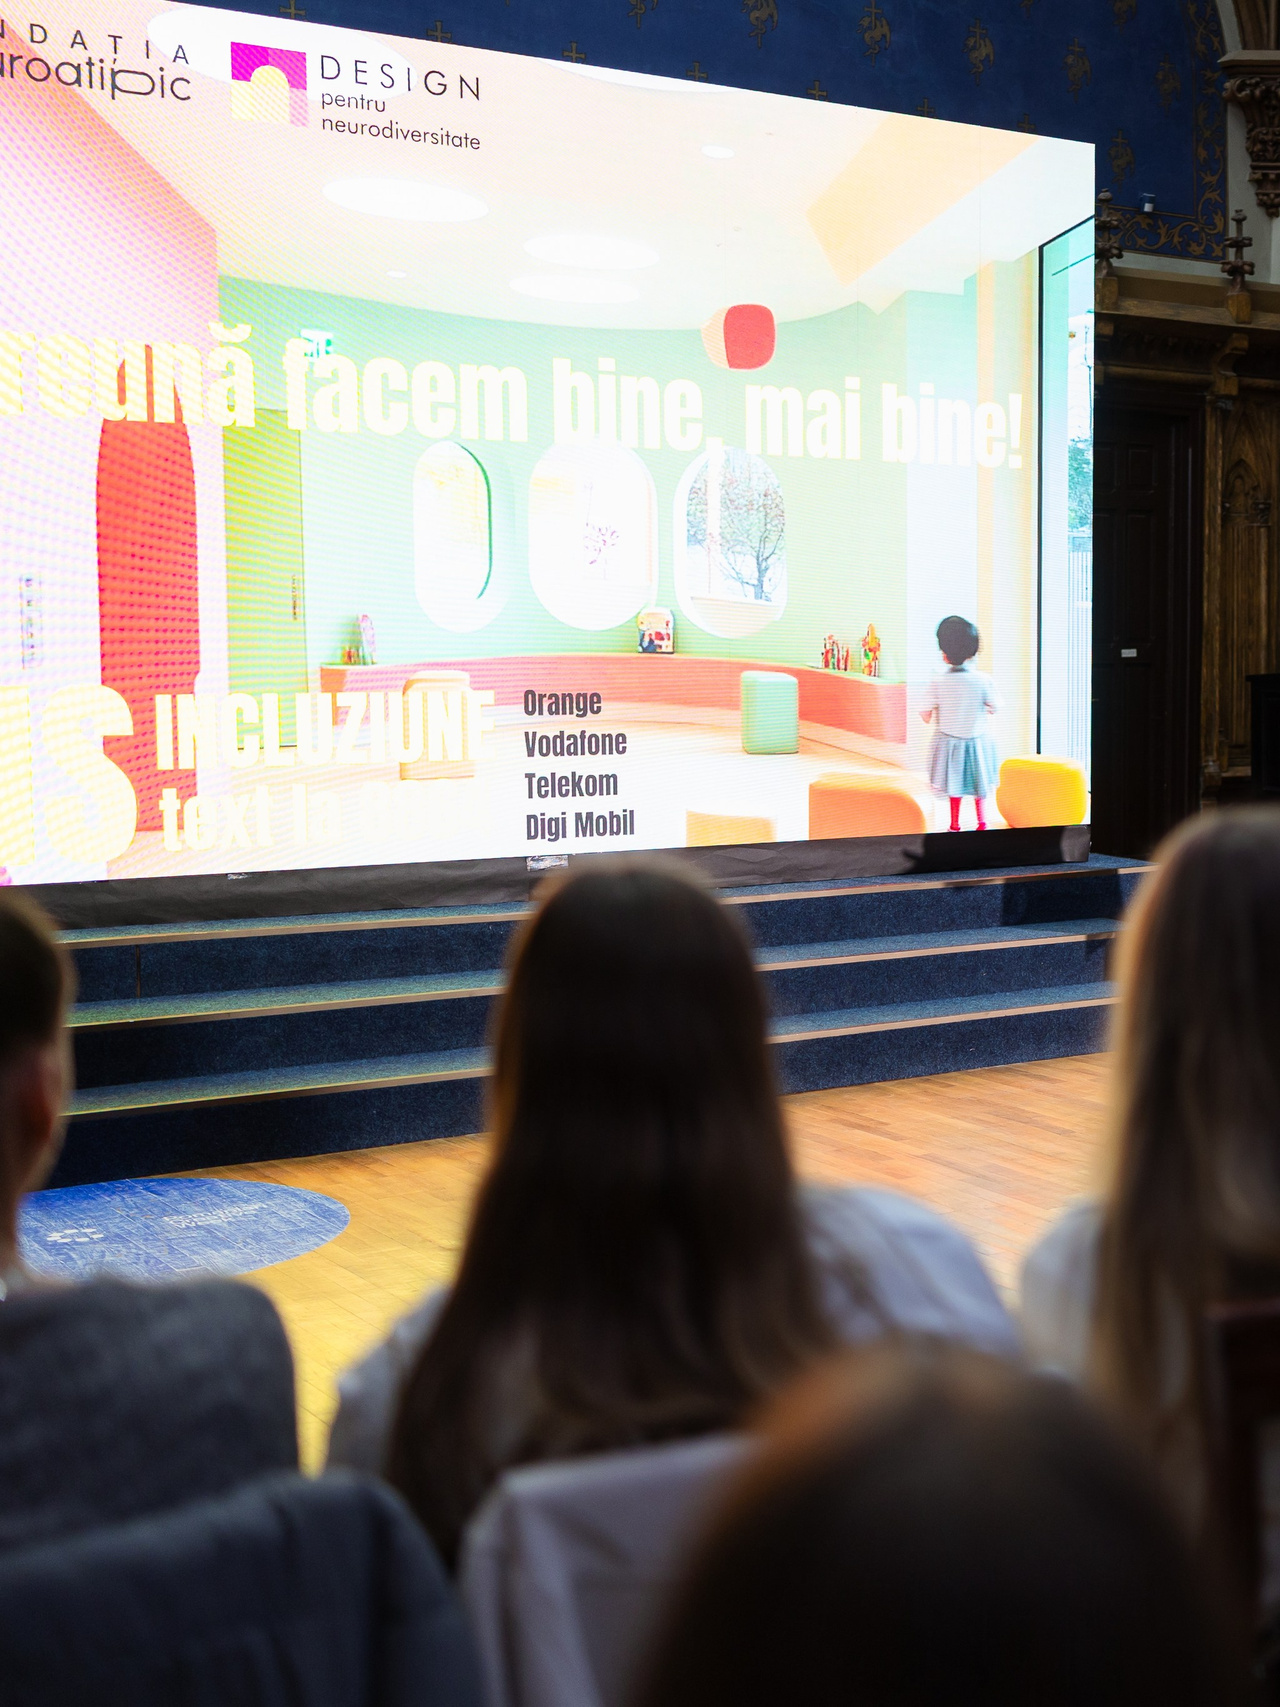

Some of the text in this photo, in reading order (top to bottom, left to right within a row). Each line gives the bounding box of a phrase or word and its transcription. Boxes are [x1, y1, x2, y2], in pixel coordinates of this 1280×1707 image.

[0, 51, 192, 102] roatipic
[320, 54, 482, 102] DESIGN
[321, 89, 386, 114] pentru
[321, 116, 481, 151] neurodiversitate
[282, 336, 528, 443] facem
[745, 375, 861, 460] mai
[881, 381, 1023, 470] bine!
[523, 689, 602, 718] Orange
[154, 689, 496, 771] INCLUZIUNE
[524, 729, 628, 758] Vodafone
[524, 771, 618, 799] Telekom
[159, 784, 274, 853] text
[526, 808, 635, 843] Digi Mobil
